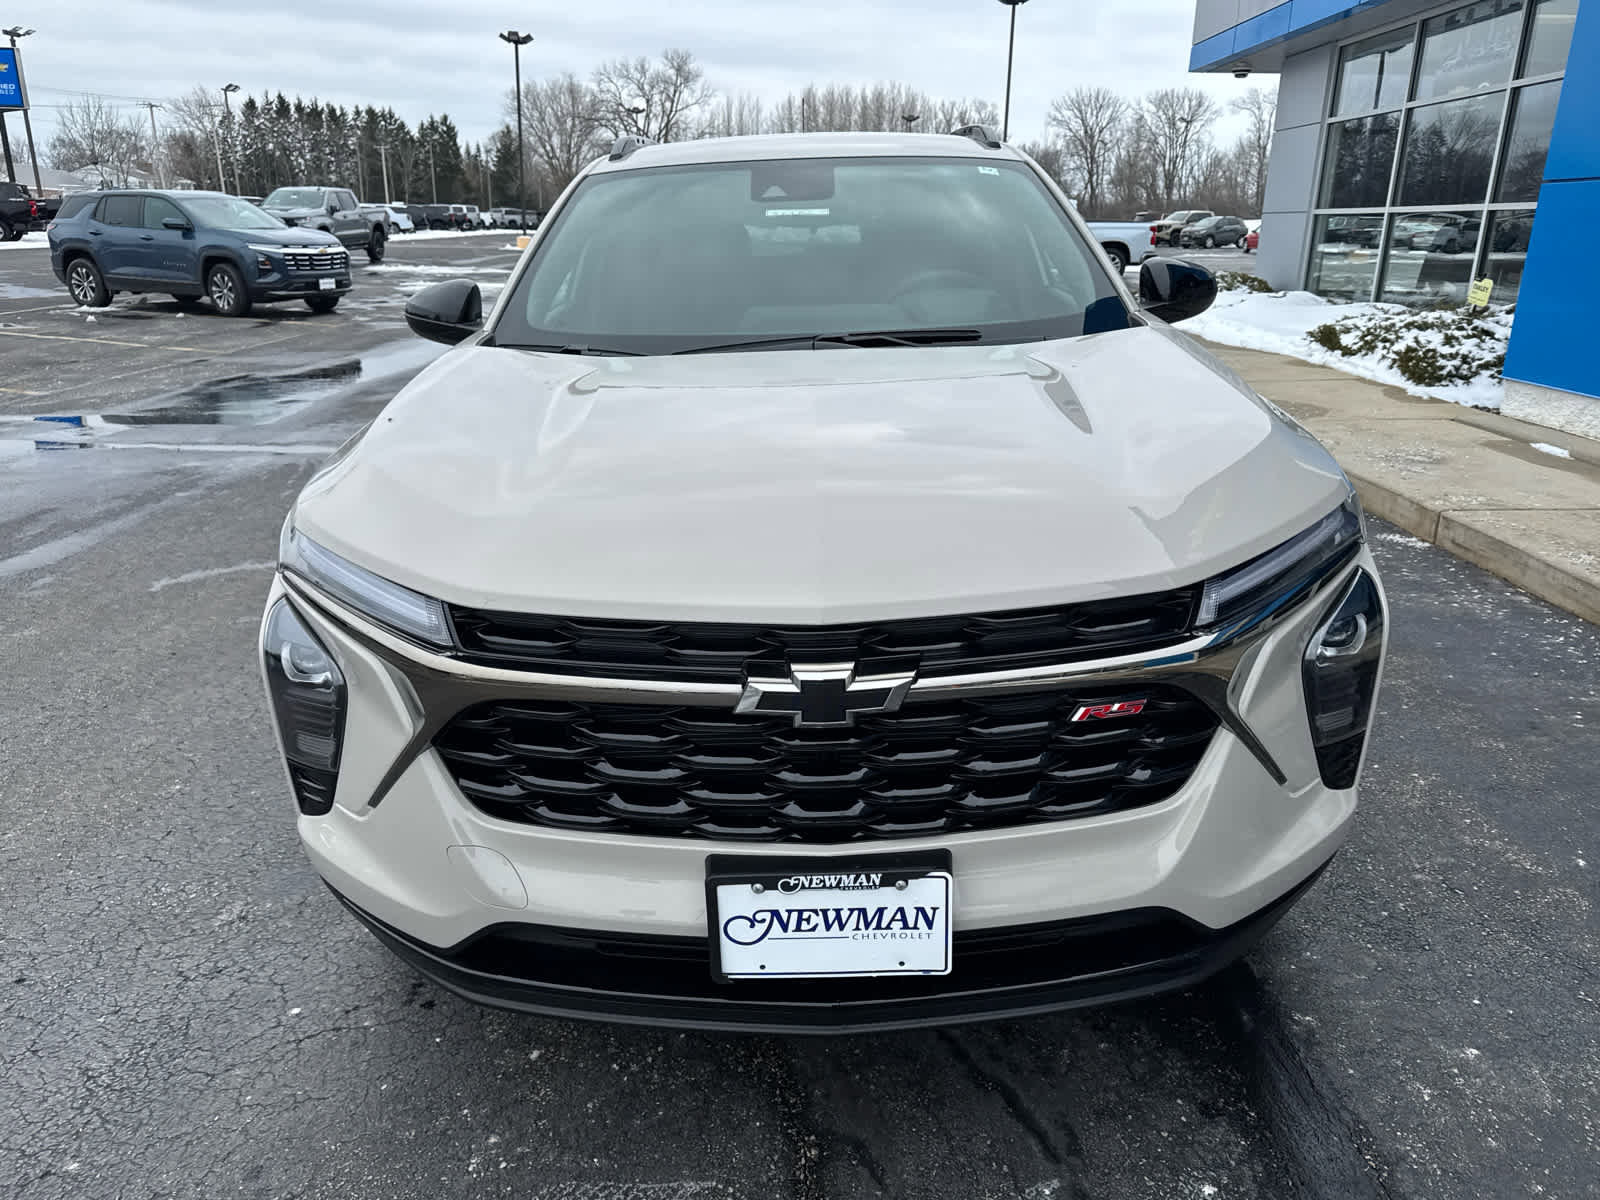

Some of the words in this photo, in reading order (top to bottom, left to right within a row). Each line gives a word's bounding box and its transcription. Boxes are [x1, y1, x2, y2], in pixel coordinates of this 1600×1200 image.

[1071, 699, 1147, 721] RS
[778, 873, 882, 894] NEWMAN
[723, 906, 939, 946] NEWMAN
[852, 932, 932, 941] CHEVROLET
